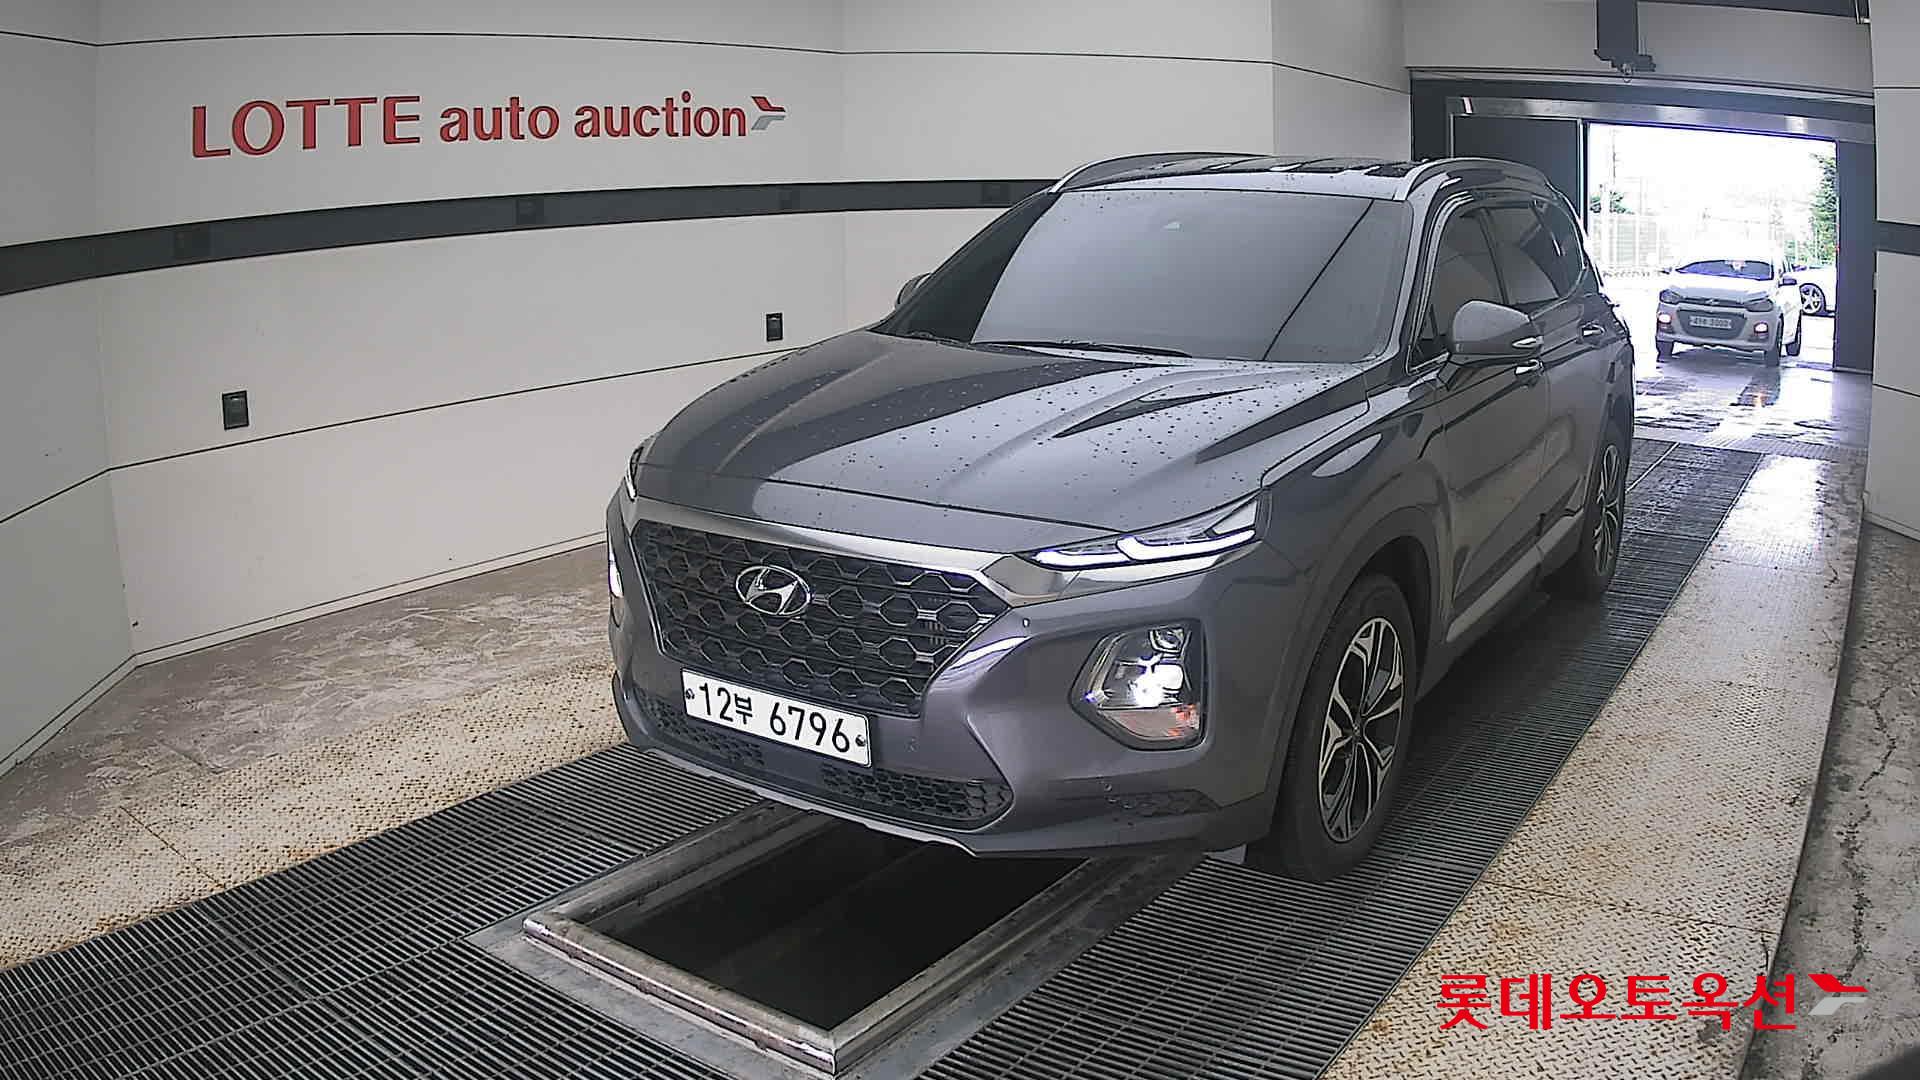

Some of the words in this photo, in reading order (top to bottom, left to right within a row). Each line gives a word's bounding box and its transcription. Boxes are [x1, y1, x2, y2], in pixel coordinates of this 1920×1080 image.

[192, 95, 421, 159] LOTTE
[438, 95, 560, 143] auto
[573, 90, 748, 139] auction
[698, 682, 753, 725] 12부
[769, 702, 850, 753] 6796
